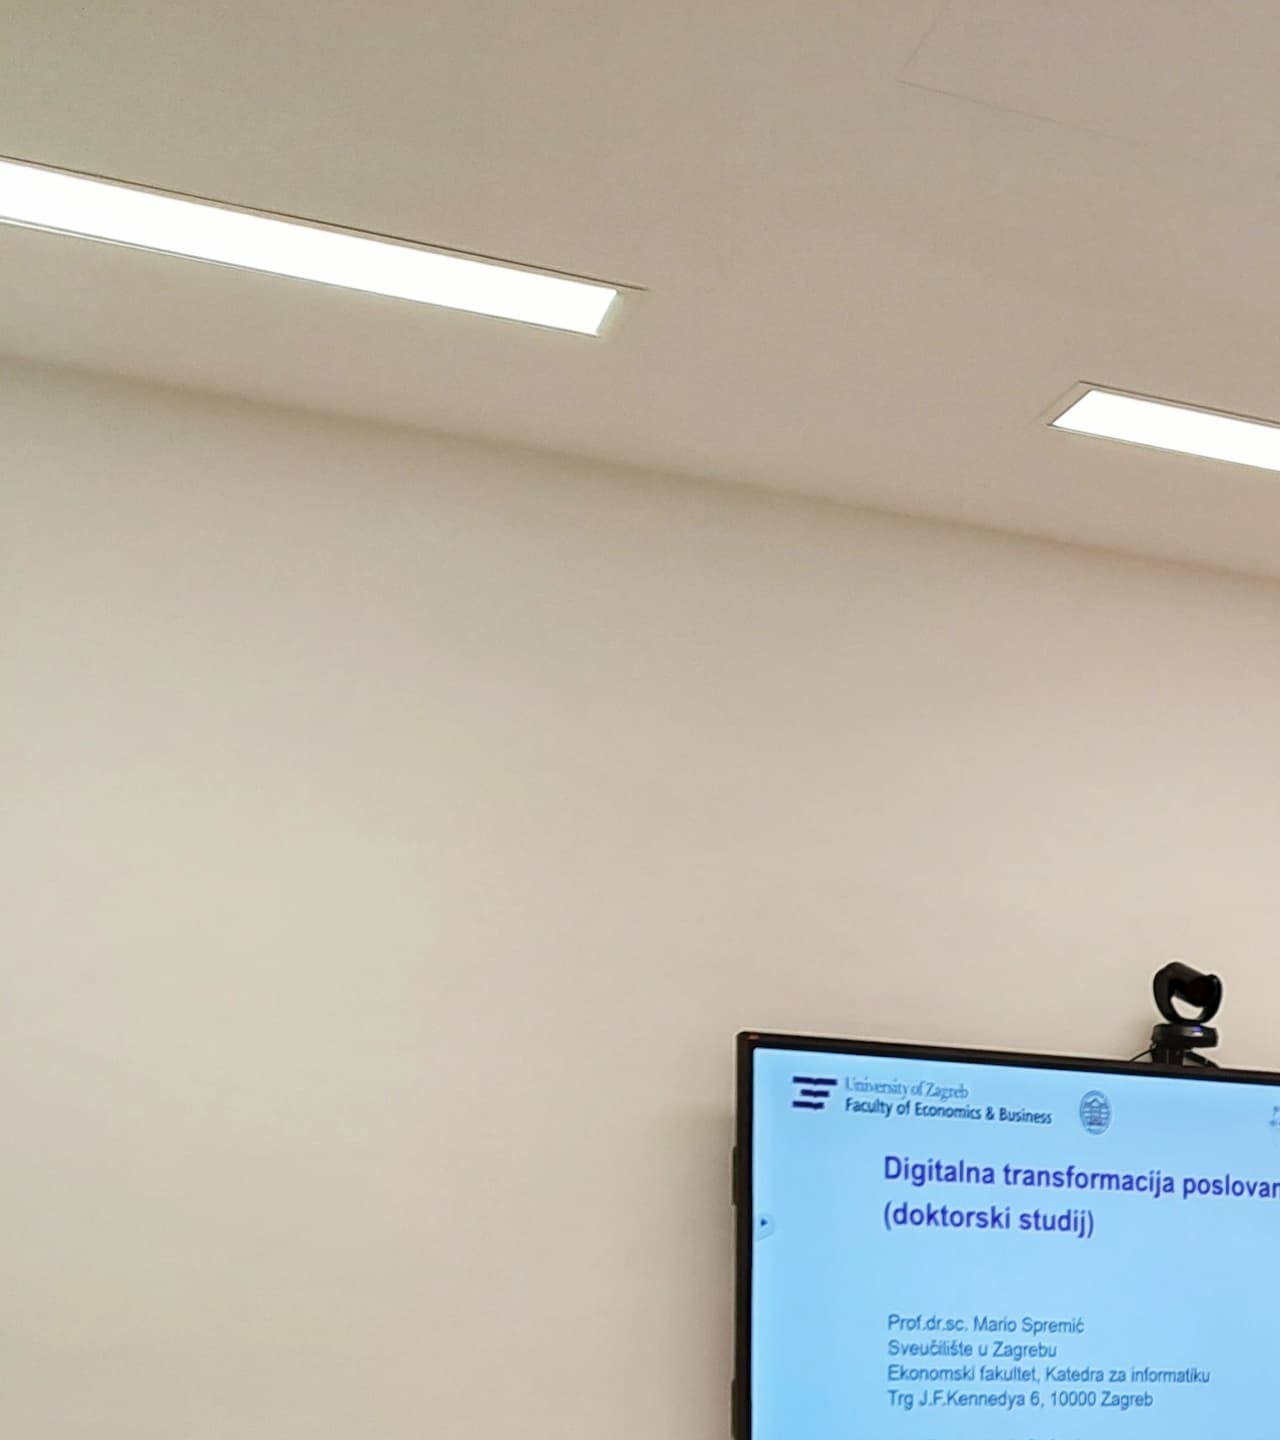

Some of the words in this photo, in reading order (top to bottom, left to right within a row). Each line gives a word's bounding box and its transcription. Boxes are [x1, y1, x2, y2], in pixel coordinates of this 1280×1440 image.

[845, 1076, 908, 1099] University
[911, 1081, 925, 1097] of
[925, 1082, 969, 1101] Zagreb
[845, 1098, 891, 1118] Faculty
[896, 1099, 911, 1116] of
[915, 1102, 981, 1120] Economics
[986, 1106, 995, 1120] &
[1000, 1107, 1052, 1125] Business
[884, 1155, 995, 1187] Digitalna
[1003, 1161, 1174, 1199] transformacija
[883, 1200, 1011, 1231] (doktorski
[1019, 1209, 1095, 1239] studij)
[888, 1314, 969, 1333] Prof.dr.sc.
[974, 1316, 1017, 1333] Mario
[1022, 1317, 1085, 1337] Spremić
[888, 1339, 973, 1358] Sveučilište
[978, 1345, 988, 1358] u
[993, 1341, 1057, 1361] Zagrebu
[888, 1365, 975, 1382] Ekonomski
[980, 1366, 1040, 1385] fakultet,
[1046, 1367, 1104, 1383] Katedra
[1109, 1371, 1127, 1383] za
[1131, 1367, 1210, 1384] informatiku
[888, 1390, 913, 1410] Trg
[918, 1390, 1026, 1411] J.F.Kennedya
[1030, 1391, 1044, 1409] 6,
[1051, 1390, 1096, 1407] 10000
[1100, 1391, 1153, 1409] Zagreb
